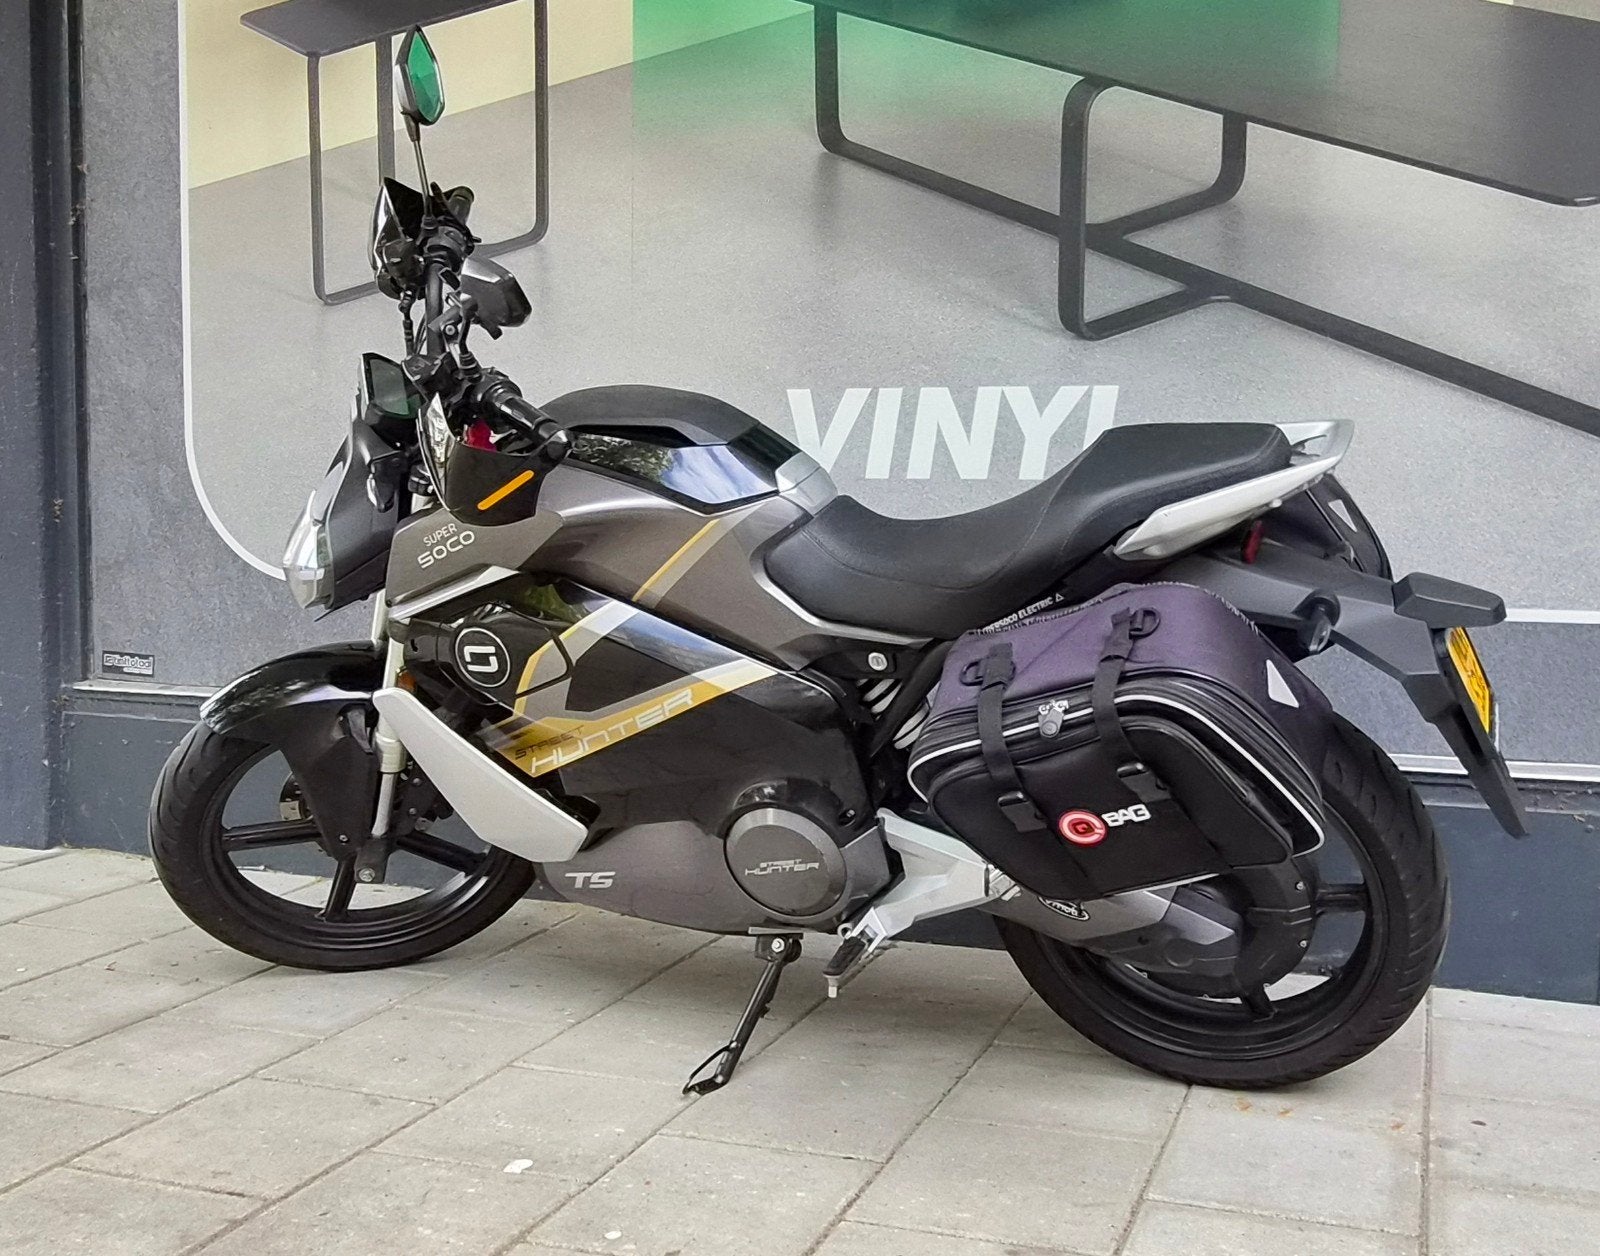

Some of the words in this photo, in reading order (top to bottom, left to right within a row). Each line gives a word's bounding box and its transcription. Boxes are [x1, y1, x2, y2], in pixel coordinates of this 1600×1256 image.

[423, 523, 458, 547] SUPER
[417, 530, 475, 569] SOCO
[1018, 596, 1054, 620] ELECTRIC
[515, 725, 585, 760] STREET
[531, 688, 693, 774] HUNTER
[564, 871, 616, 889] TS
[745, 862, 819, 876] HUNTER
